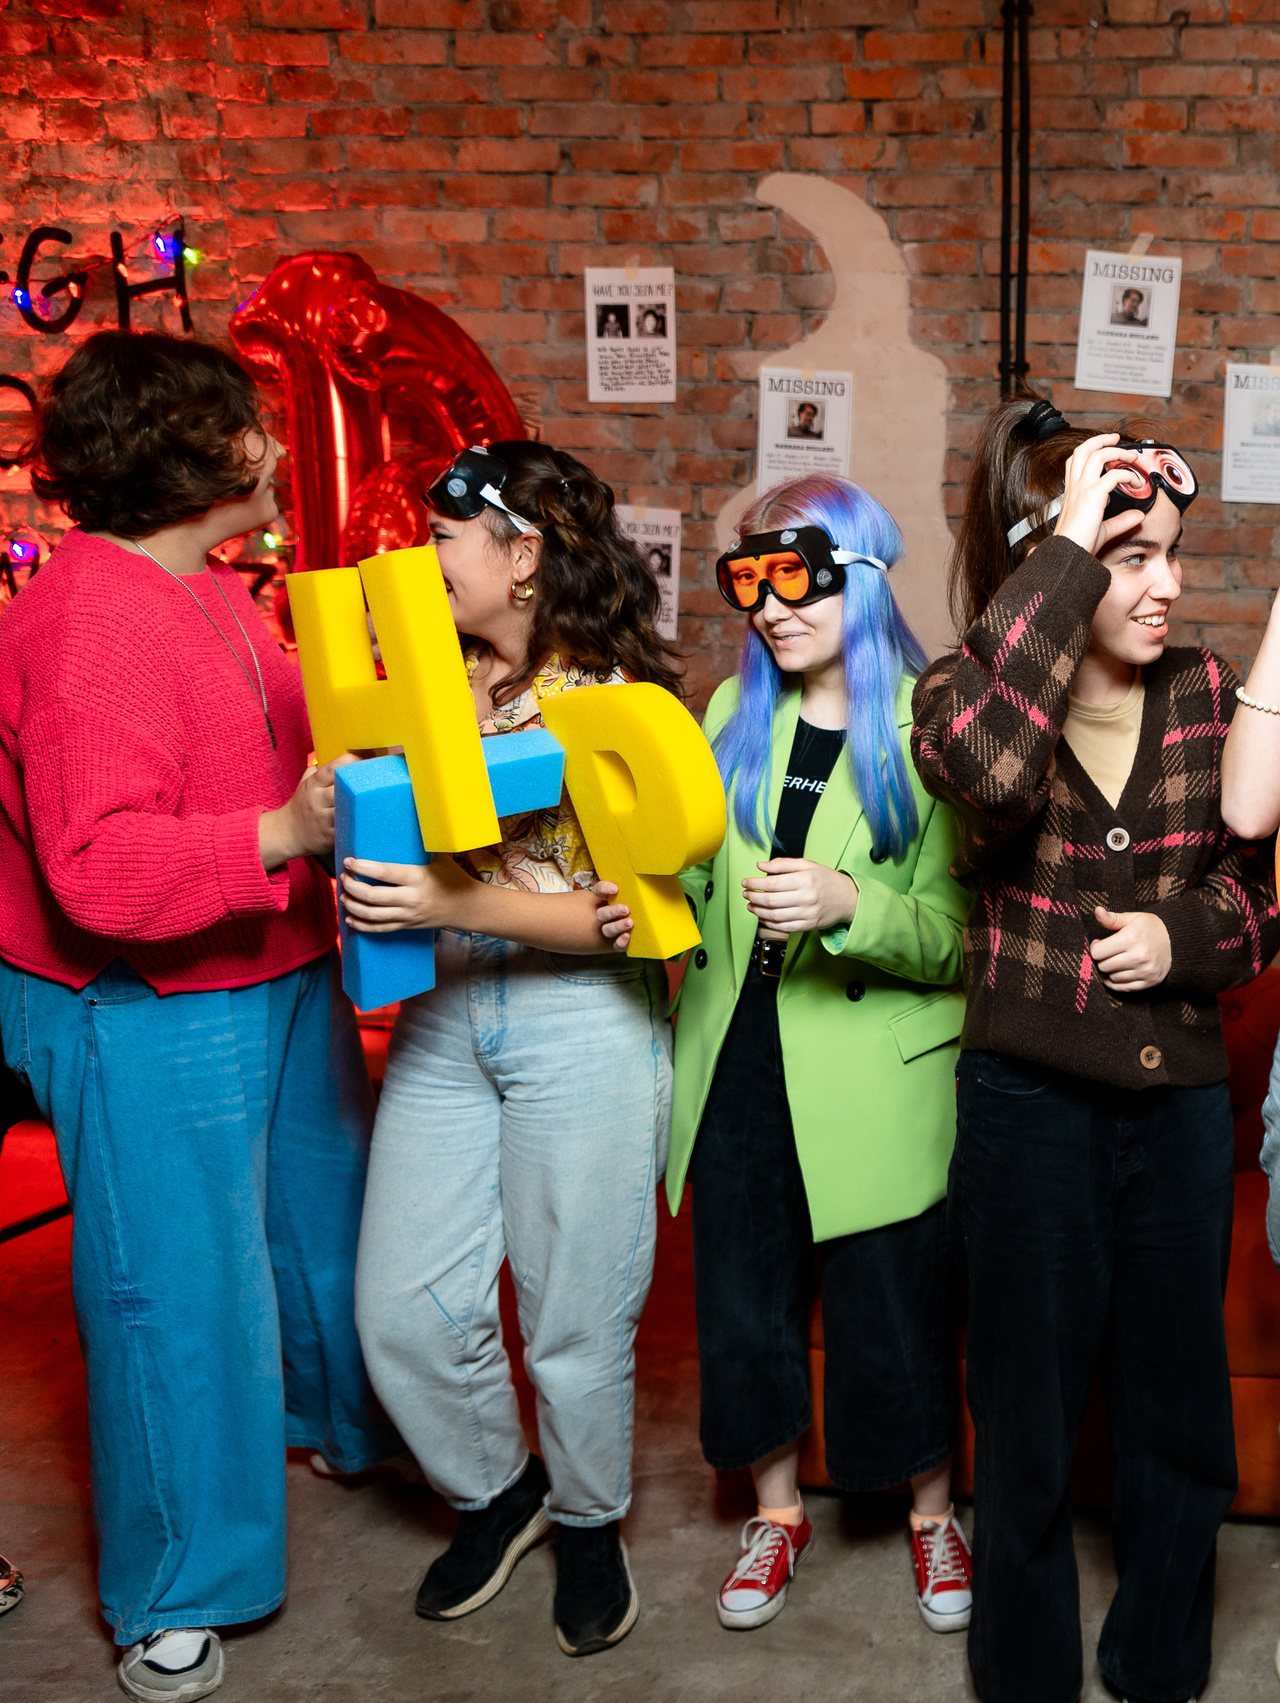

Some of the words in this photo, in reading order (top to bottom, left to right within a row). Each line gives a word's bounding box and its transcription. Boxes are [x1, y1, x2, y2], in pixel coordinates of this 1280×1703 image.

[1092, 262, 1175, 283] MISSING
[593, 285, 614, 297] HAVE
[618, 285, 632, 296] YOU
[656, 284, 674, 296] ME?
[768, 378, 846, 397] MISSING
[626, 522, 639, 535] YOU
